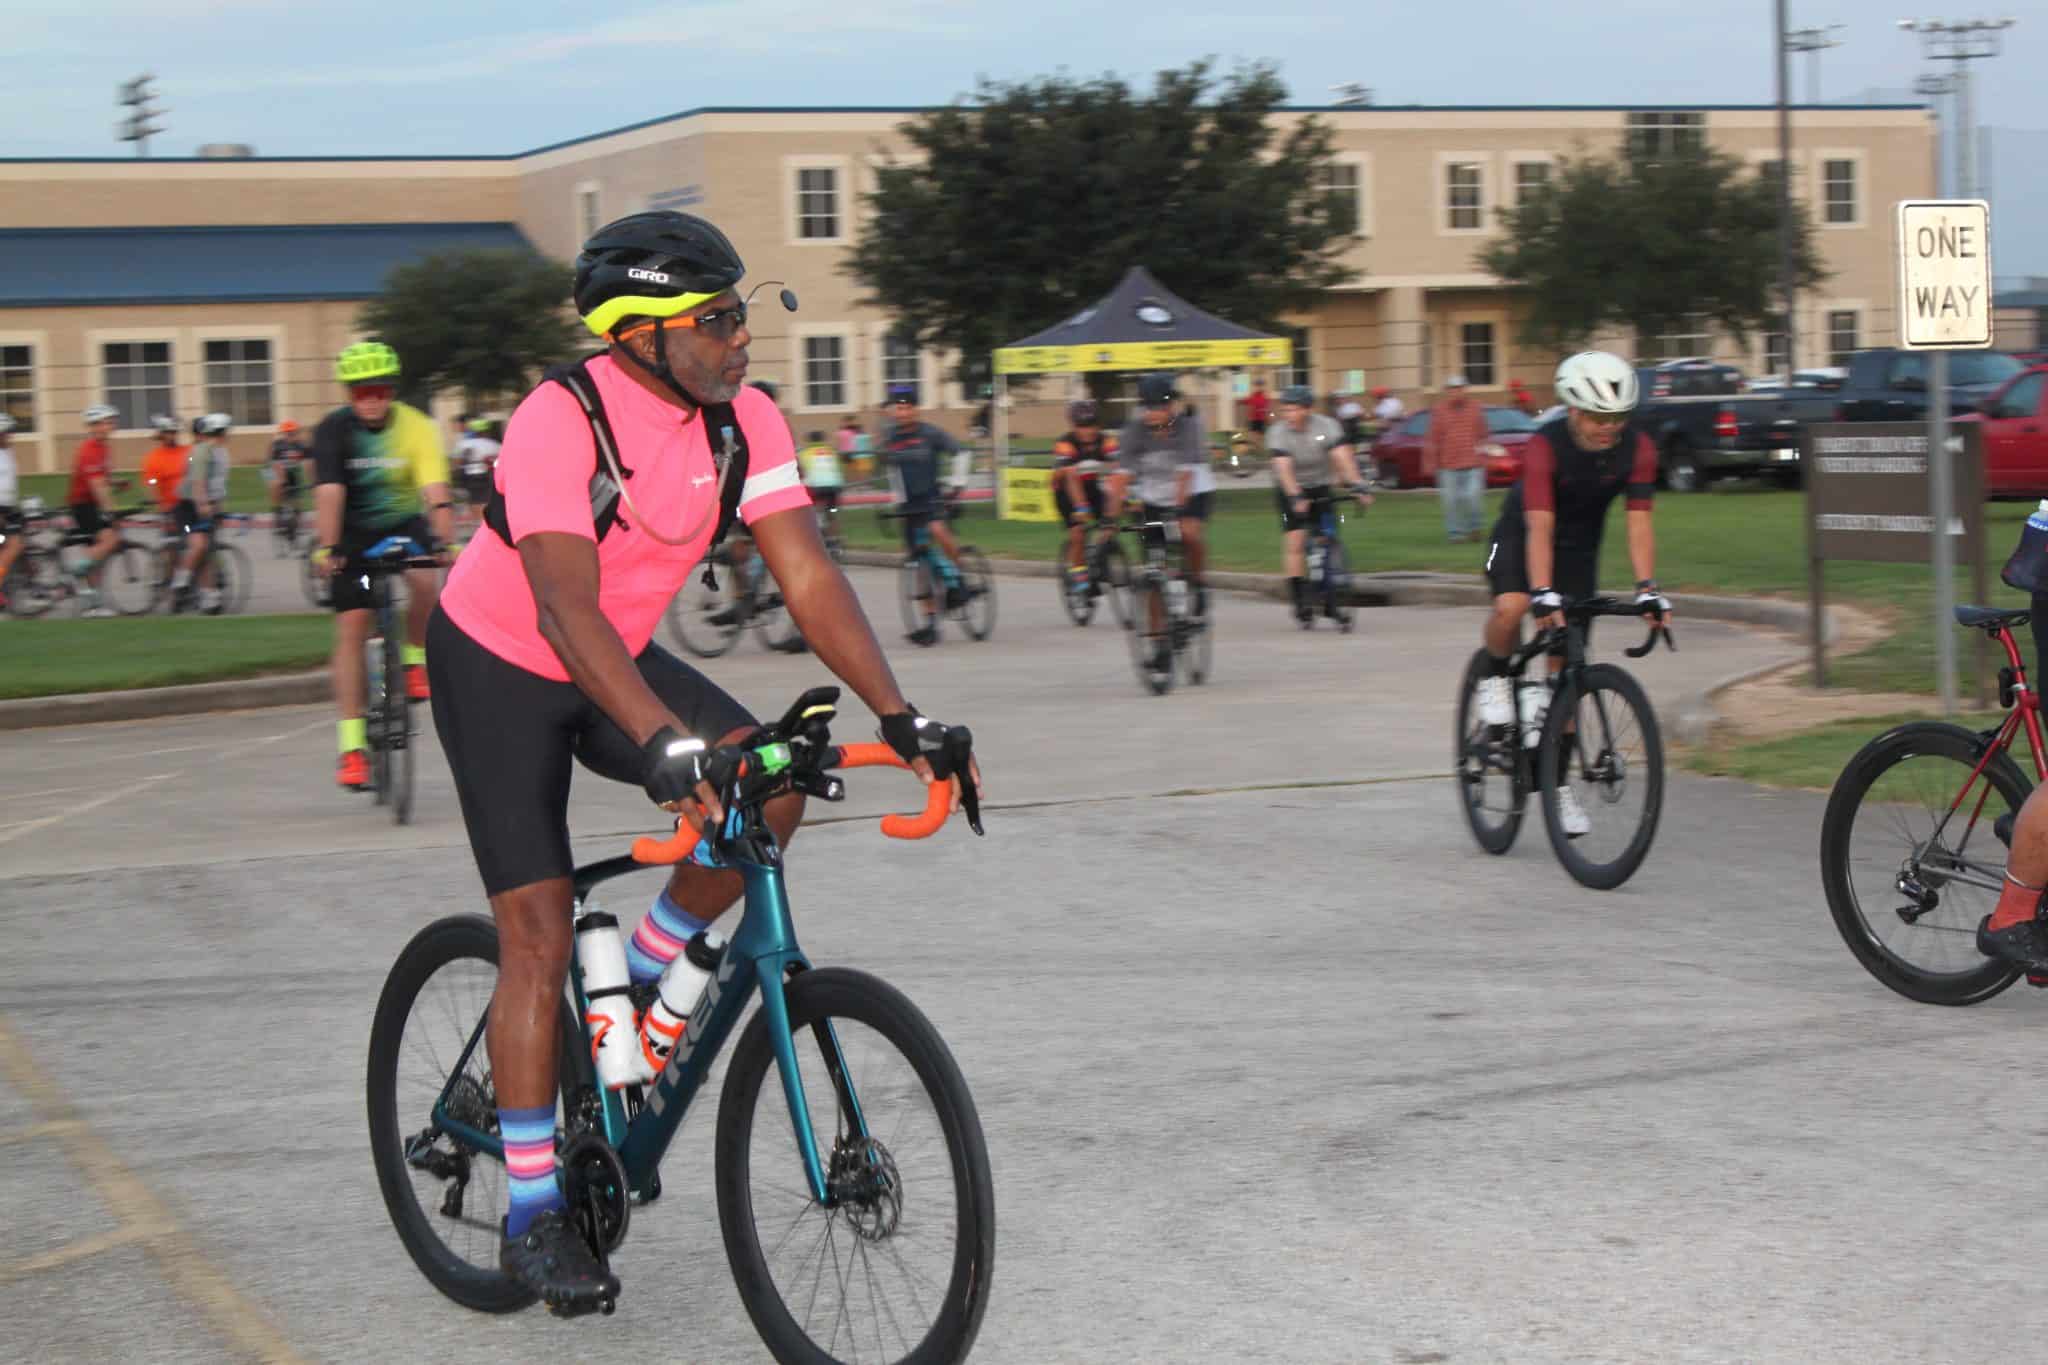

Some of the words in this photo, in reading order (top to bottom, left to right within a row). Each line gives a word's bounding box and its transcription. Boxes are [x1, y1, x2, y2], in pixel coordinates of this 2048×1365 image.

[1917, 226, 1977, 258] ONE
[628, 268, 669, 284] GIRO
[1915, 285, 1979, 318] WAY
[641, 941, 737, 1117] TREK
